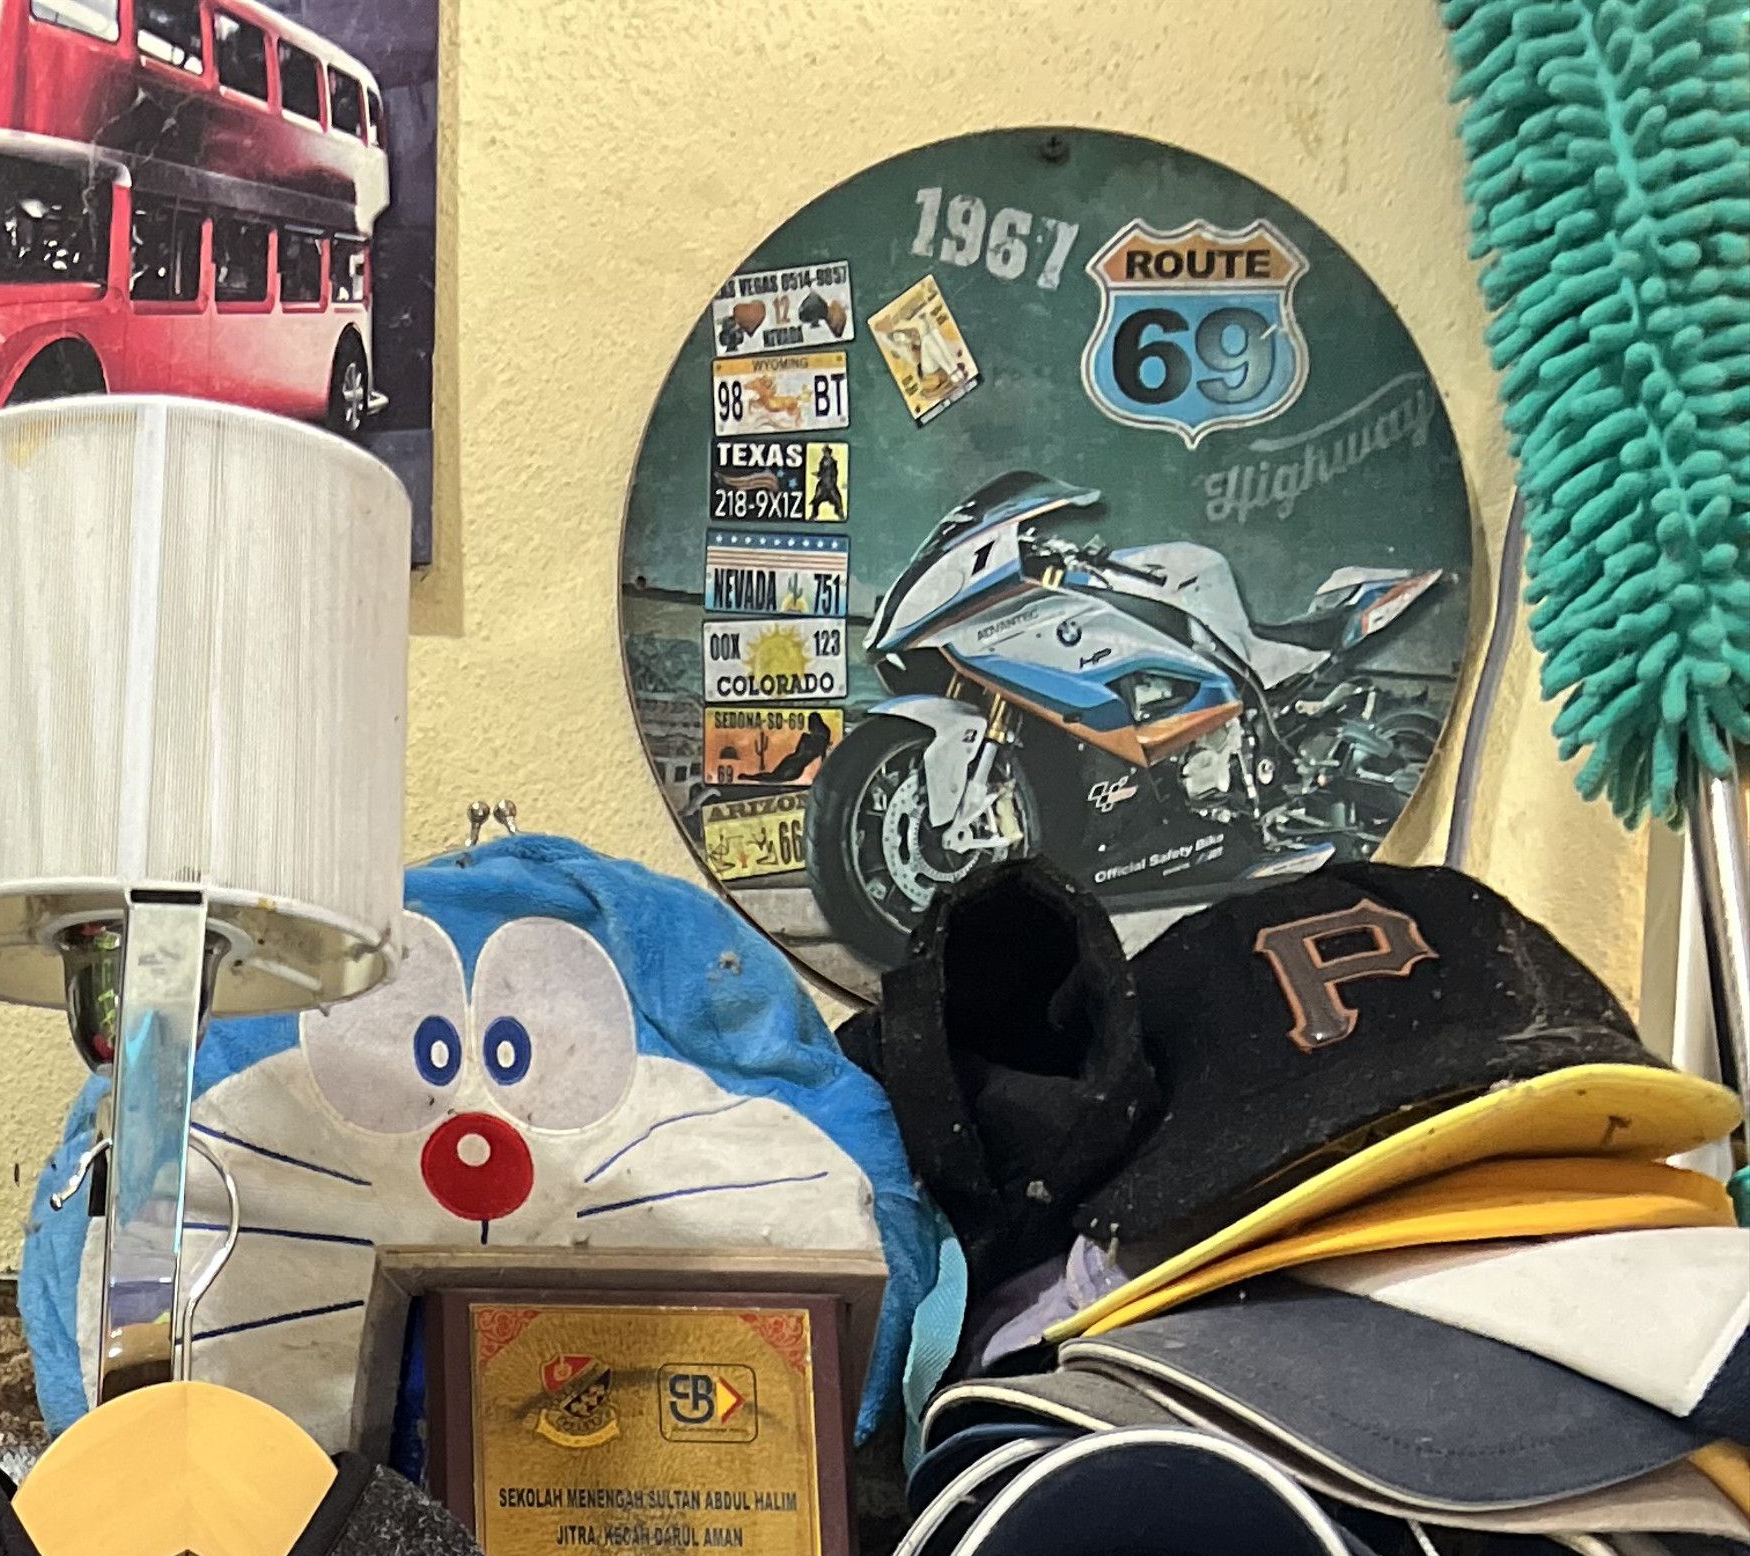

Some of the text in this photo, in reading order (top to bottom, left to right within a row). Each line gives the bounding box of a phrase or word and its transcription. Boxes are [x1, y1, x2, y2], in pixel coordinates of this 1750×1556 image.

[910, 186, 1080, 290] 1967
[1125, 248, 1272, 280] ROUTE
[772, 294, 791, 325] 12
[751, 357, 809, 372] WYOMING
[1111, 306, 1279, 405] 69
[717, 373, 846, 422] 98 BT
[716, 442, 803, 468] TEXAS
[1203, 385, 1436, 524] Highway
[971, 540, 996, 577] 1
[713, 567, 841, 616] NEVADA 751
[813, 628, 841, 657] 123
[716, 671, 835, 697] COLORADO
[1094, 857, 1147, 884] Official
[1149, 844, 1193, 869] Safety
[1252, 898, 1441, 1053] P
[499, 1487, 797, 1512] SEKOLAH MENENGAH SULTAN ABDUL HALIM
[653, 1526, 700, 1547] DARUL
[703, 1527, 743, 1548] AMAN
